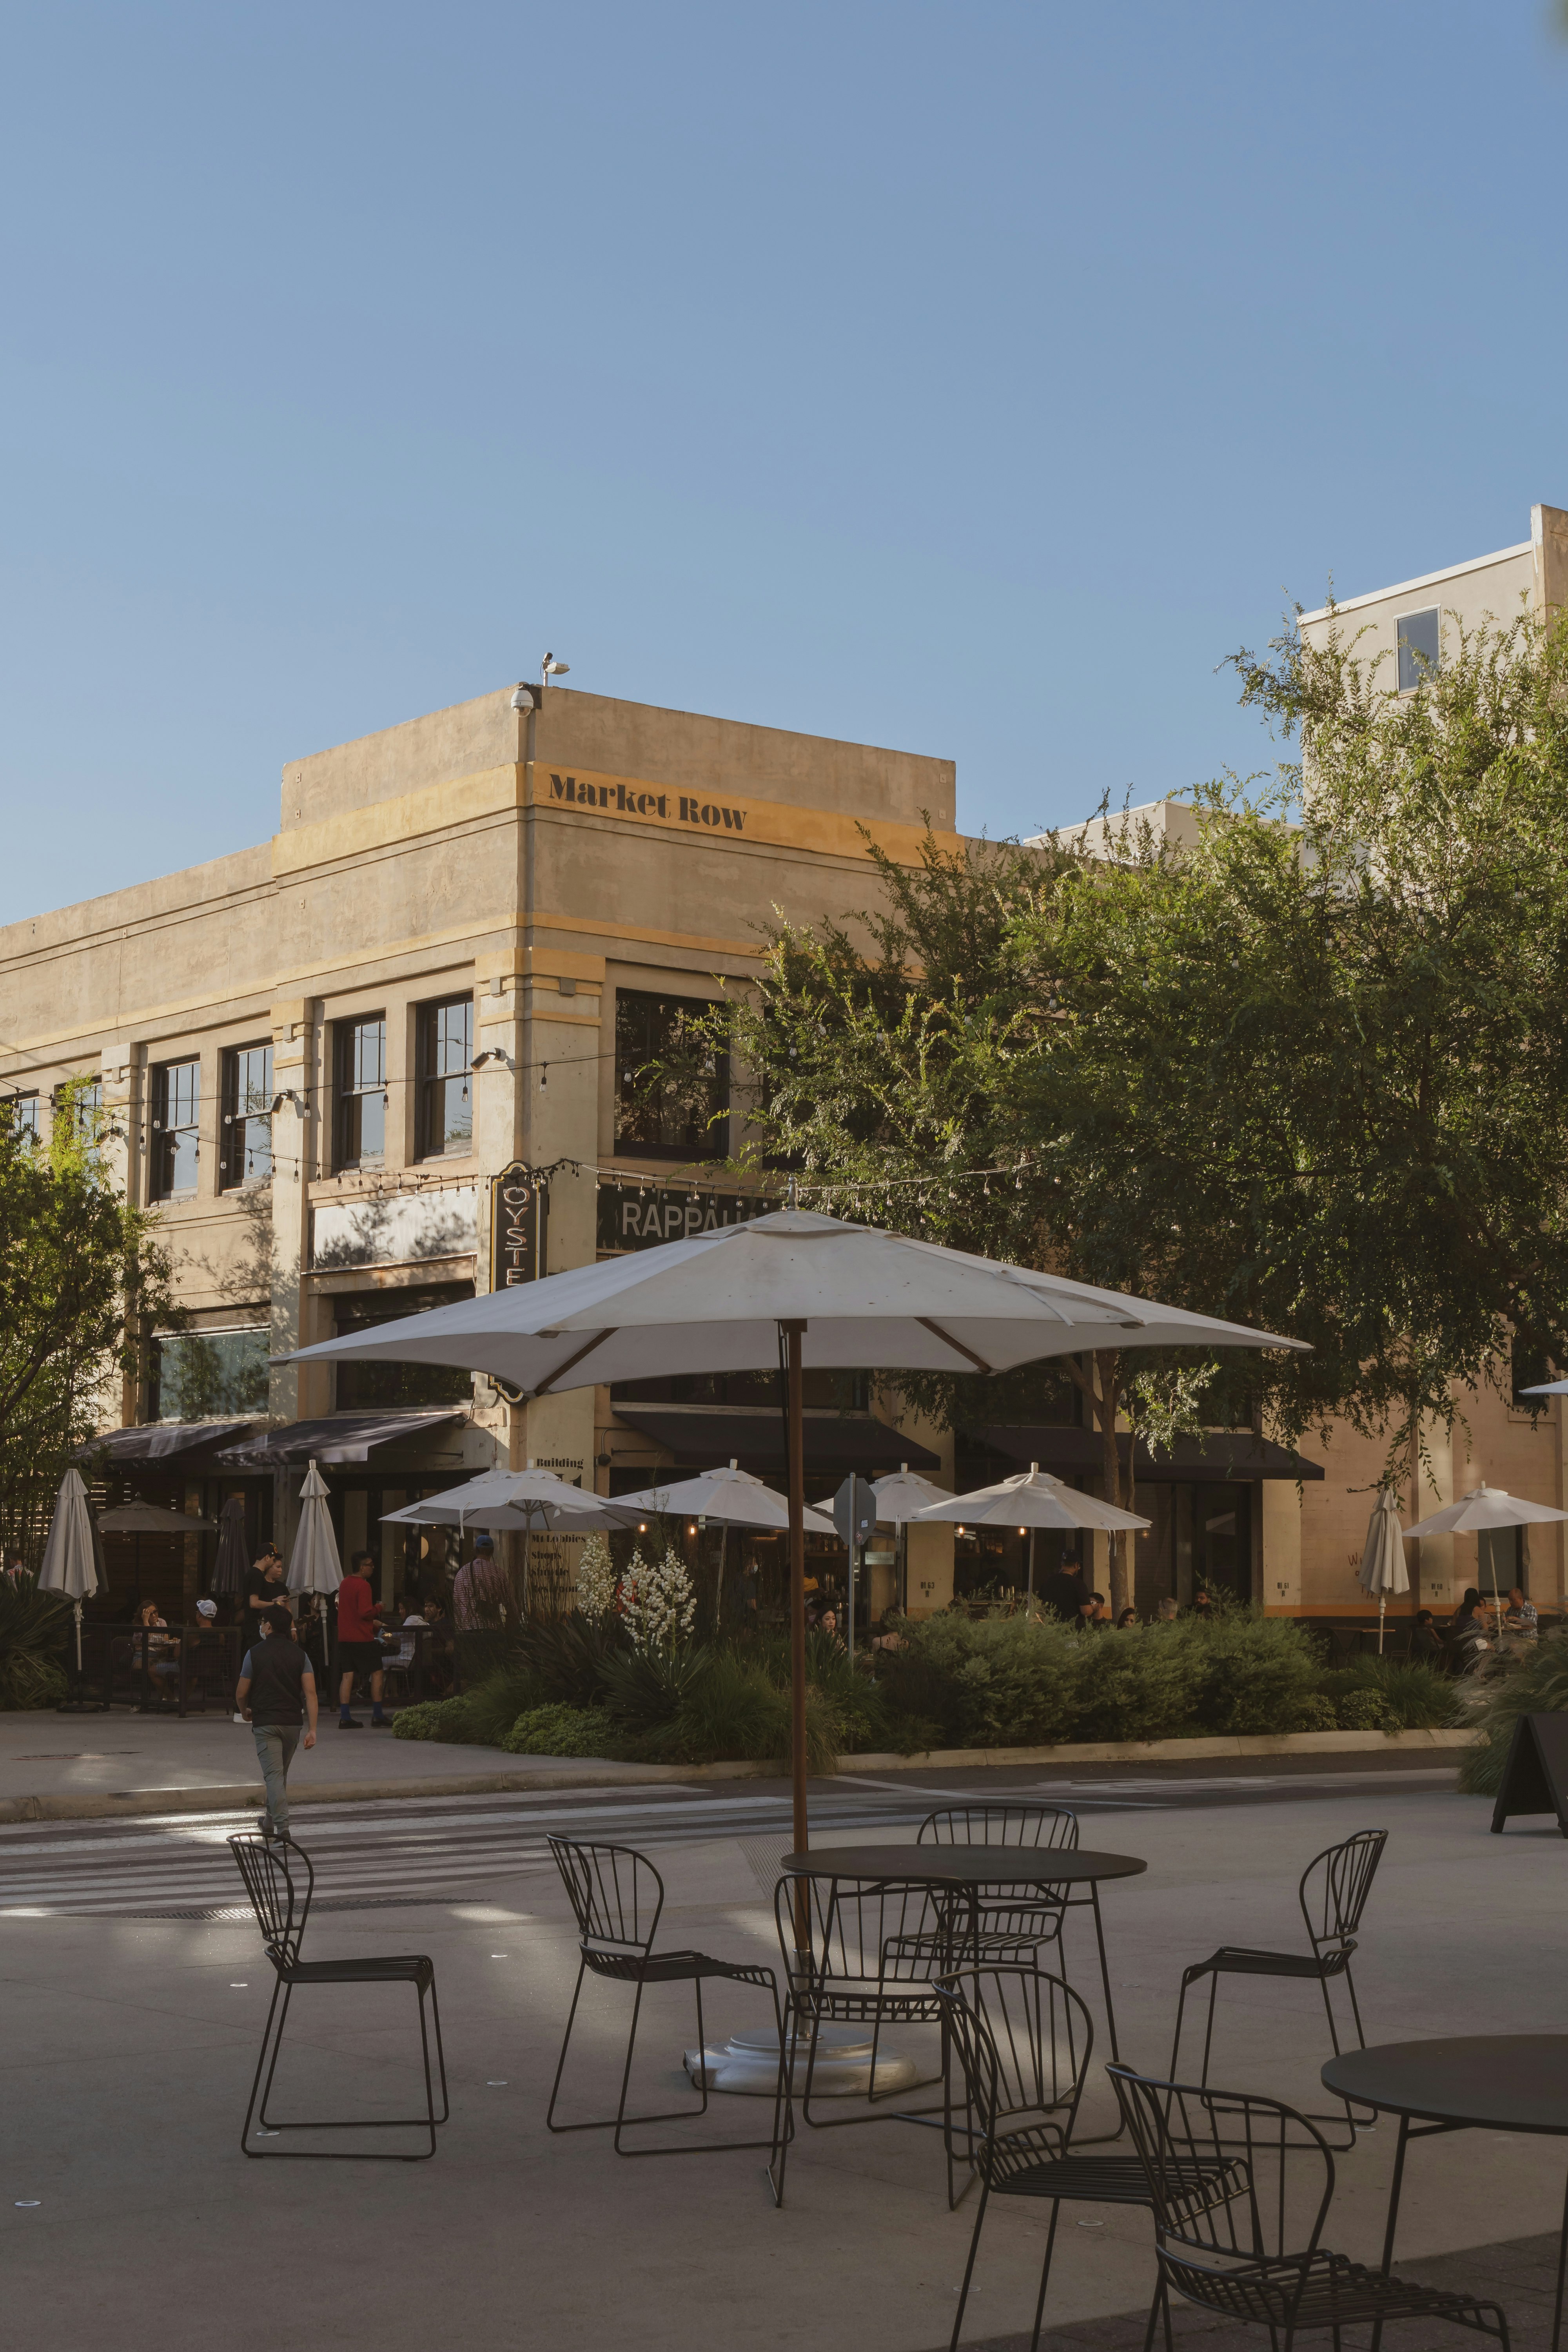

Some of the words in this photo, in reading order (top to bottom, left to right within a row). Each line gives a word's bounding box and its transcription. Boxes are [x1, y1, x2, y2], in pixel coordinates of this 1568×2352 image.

[549, 773, 671, 819] Market
[678, 796, 748, 831] Row
[622, 1202, 757, 1238] RAPPAH
[537, 1458, 584, 1470] Building
[546, 1534, 586, 1543] Lobbies
[531, 1551, 562, 1561] Shops
